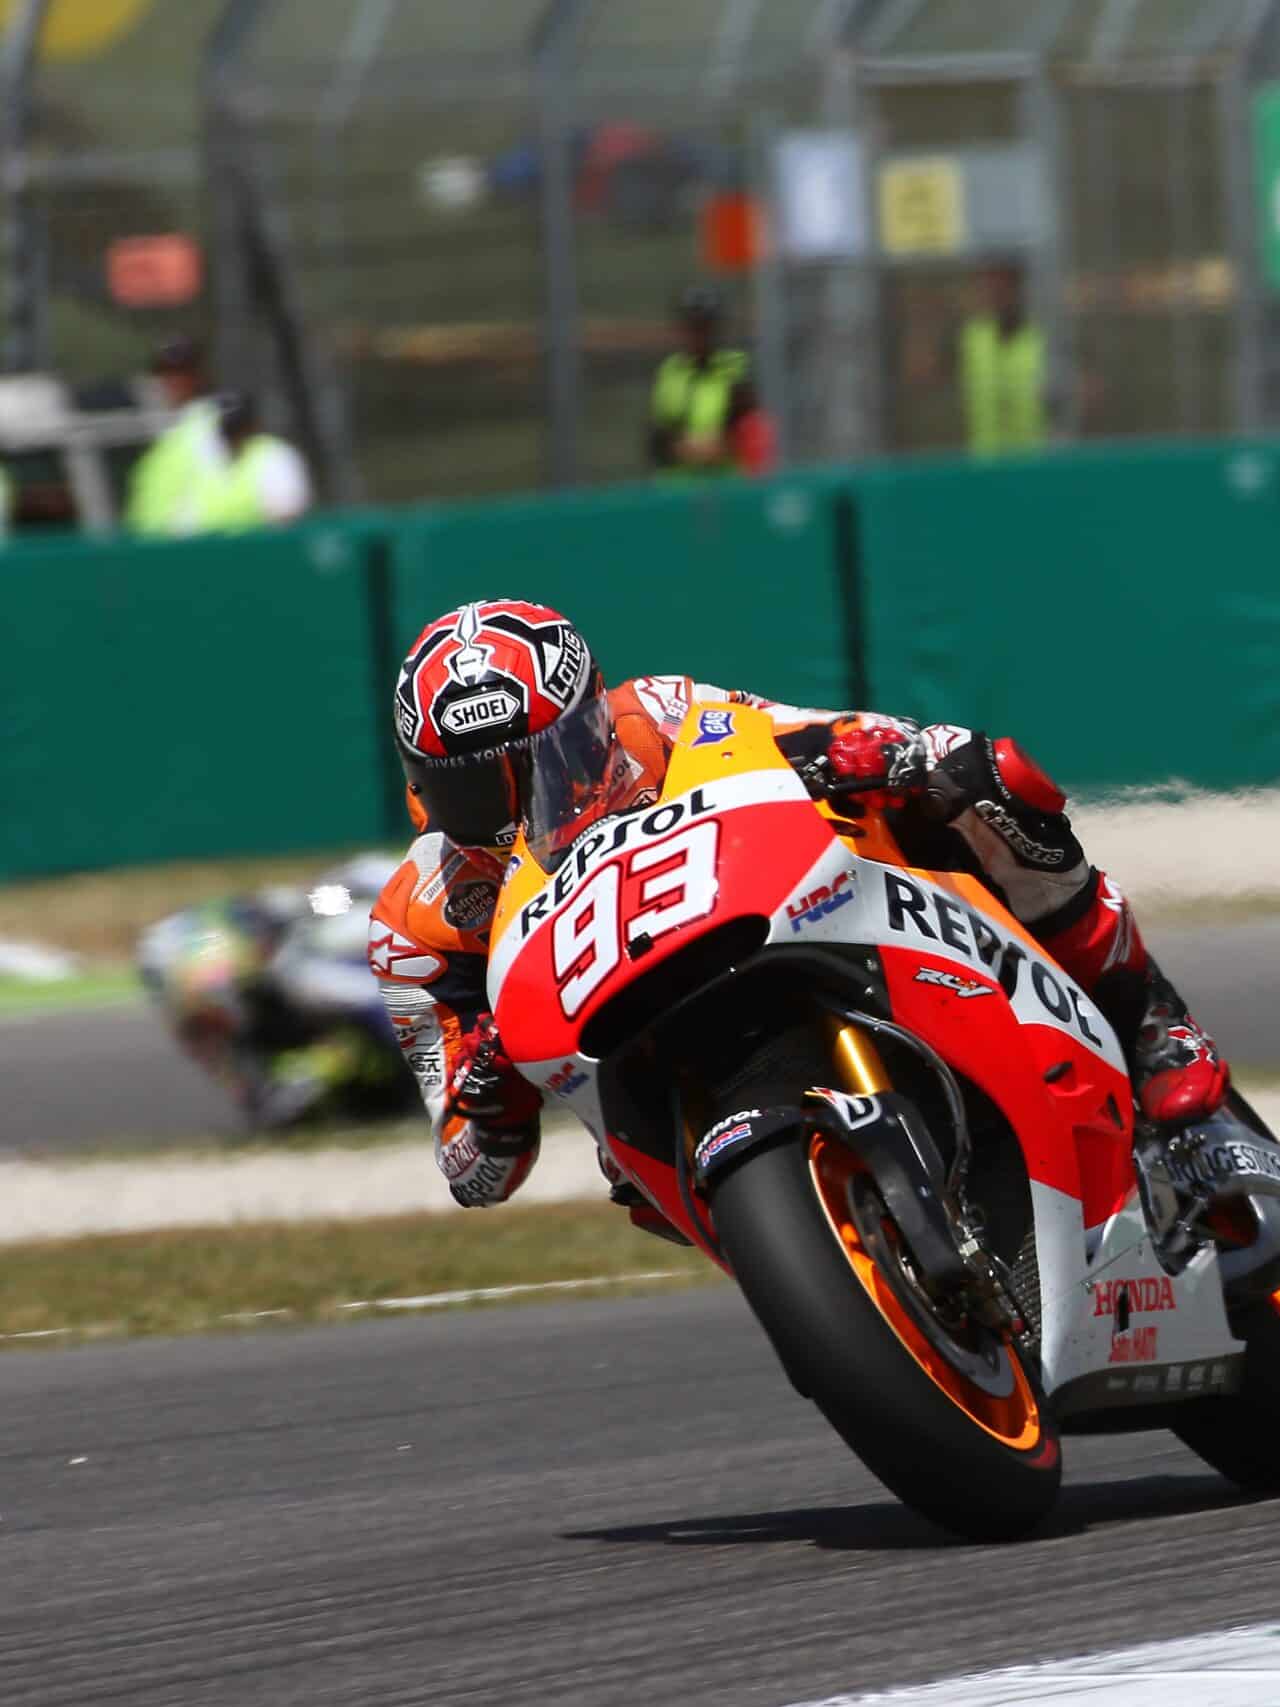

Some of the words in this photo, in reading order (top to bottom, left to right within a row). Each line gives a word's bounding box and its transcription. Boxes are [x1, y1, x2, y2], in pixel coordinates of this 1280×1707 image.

[549, 630, 580, 699] LOTUS
[452, 699, 509, 728] SHOEI
[473, 747, 505, 765] YOU
[521, 788, 717, 940] REPSOL
[551, 818, 723, 1023] 93
[883, 870, 1104, 1050] REPSOL
[1092, 1276, 1176, 1317] HONDA
